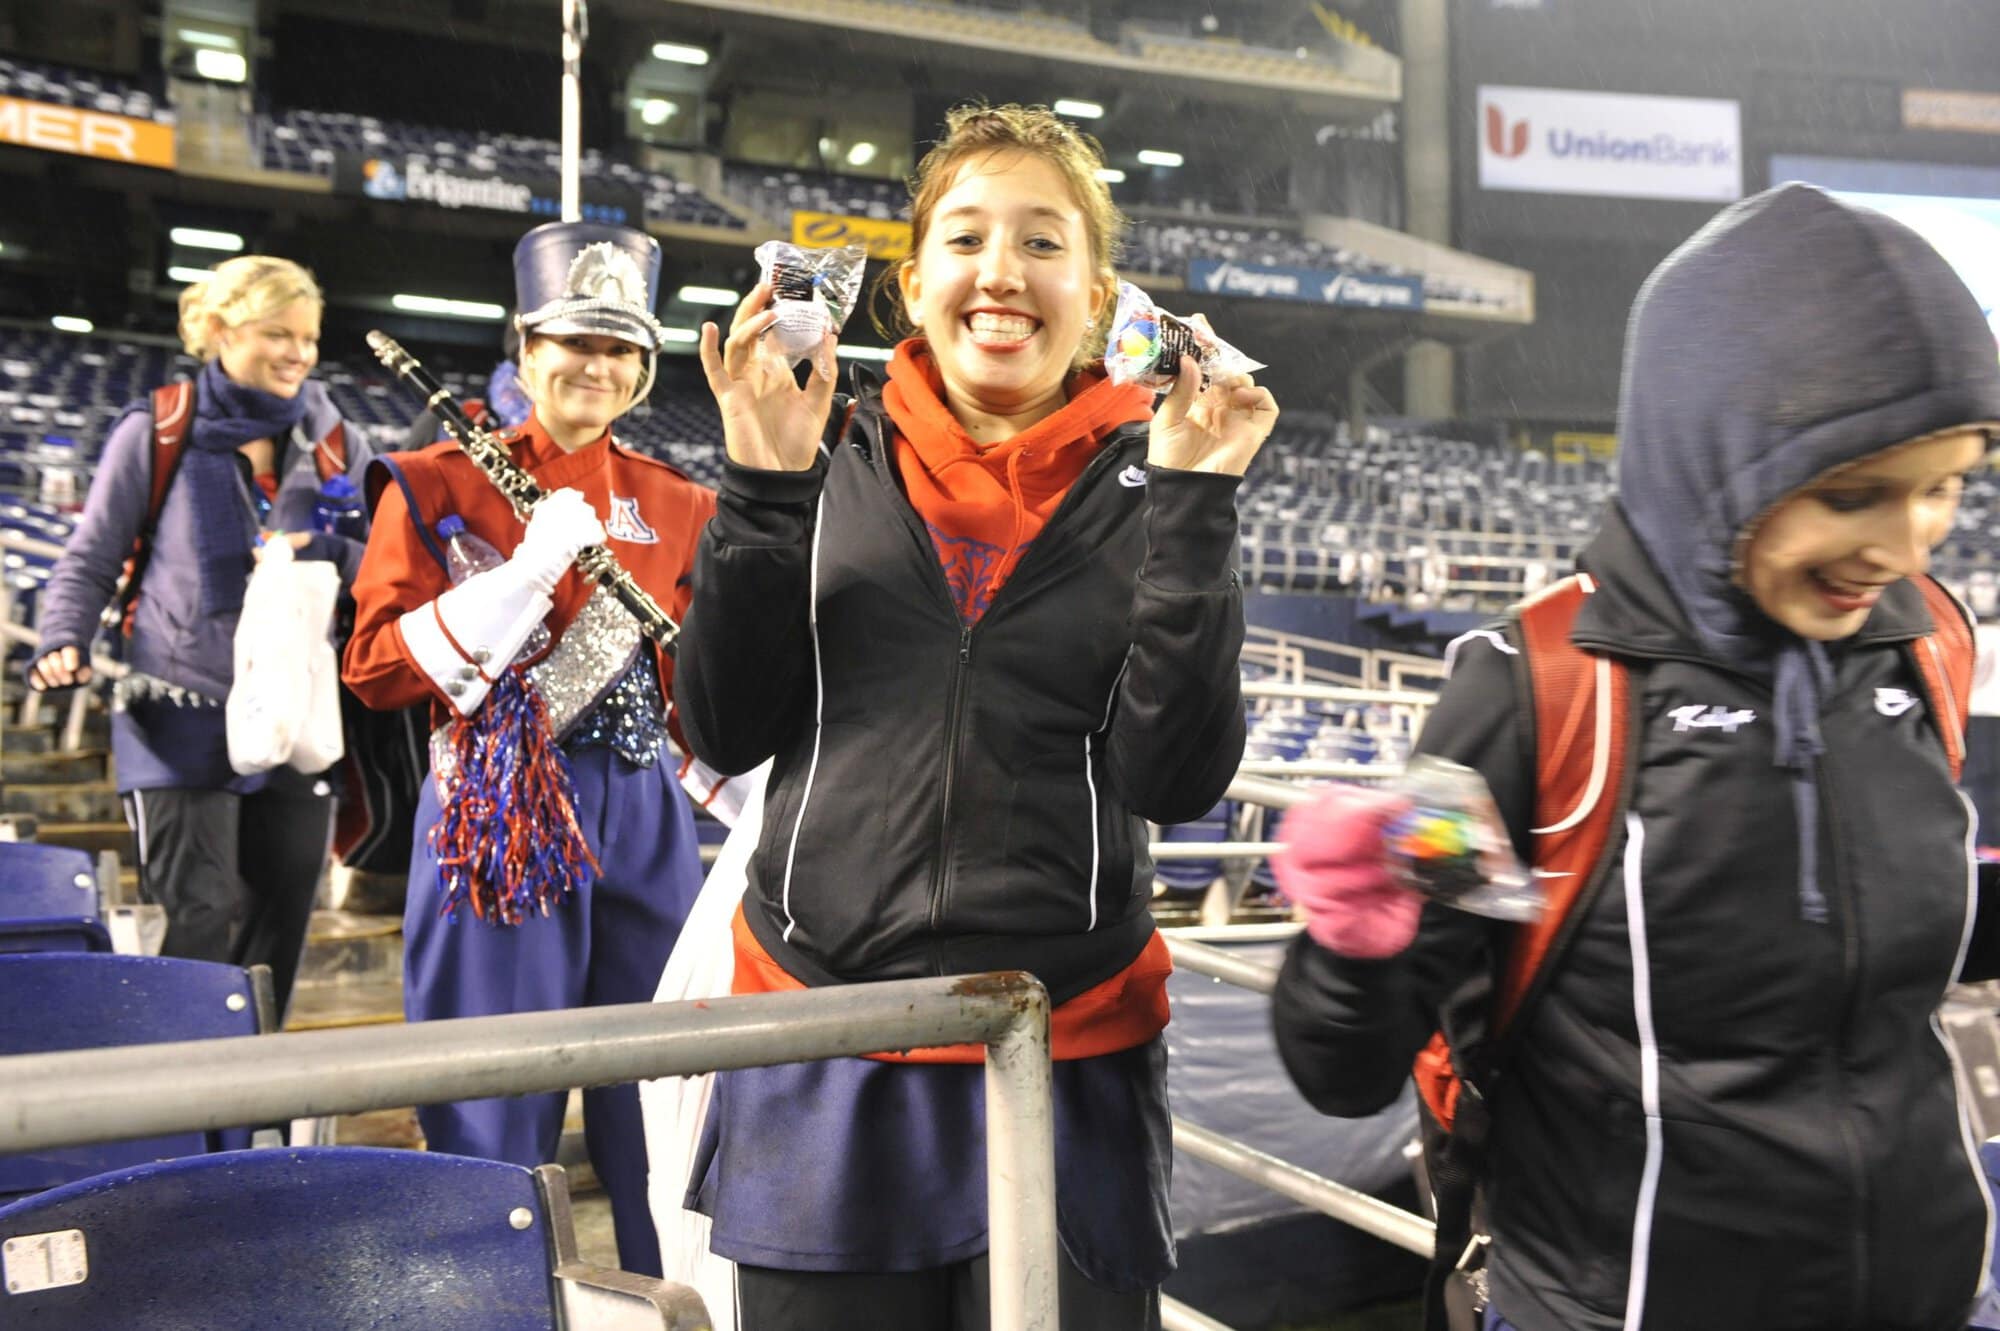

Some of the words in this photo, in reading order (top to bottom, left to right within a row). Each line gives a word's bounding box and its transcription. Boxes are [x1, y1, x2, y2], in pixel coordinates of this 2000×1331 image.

[1547, 130, 1731, 166] UnionBank
[1226, 265, 1298, 297] Degree
[1342, 277, 1411, 307] Degree
[604, 495, 660, 544] A
